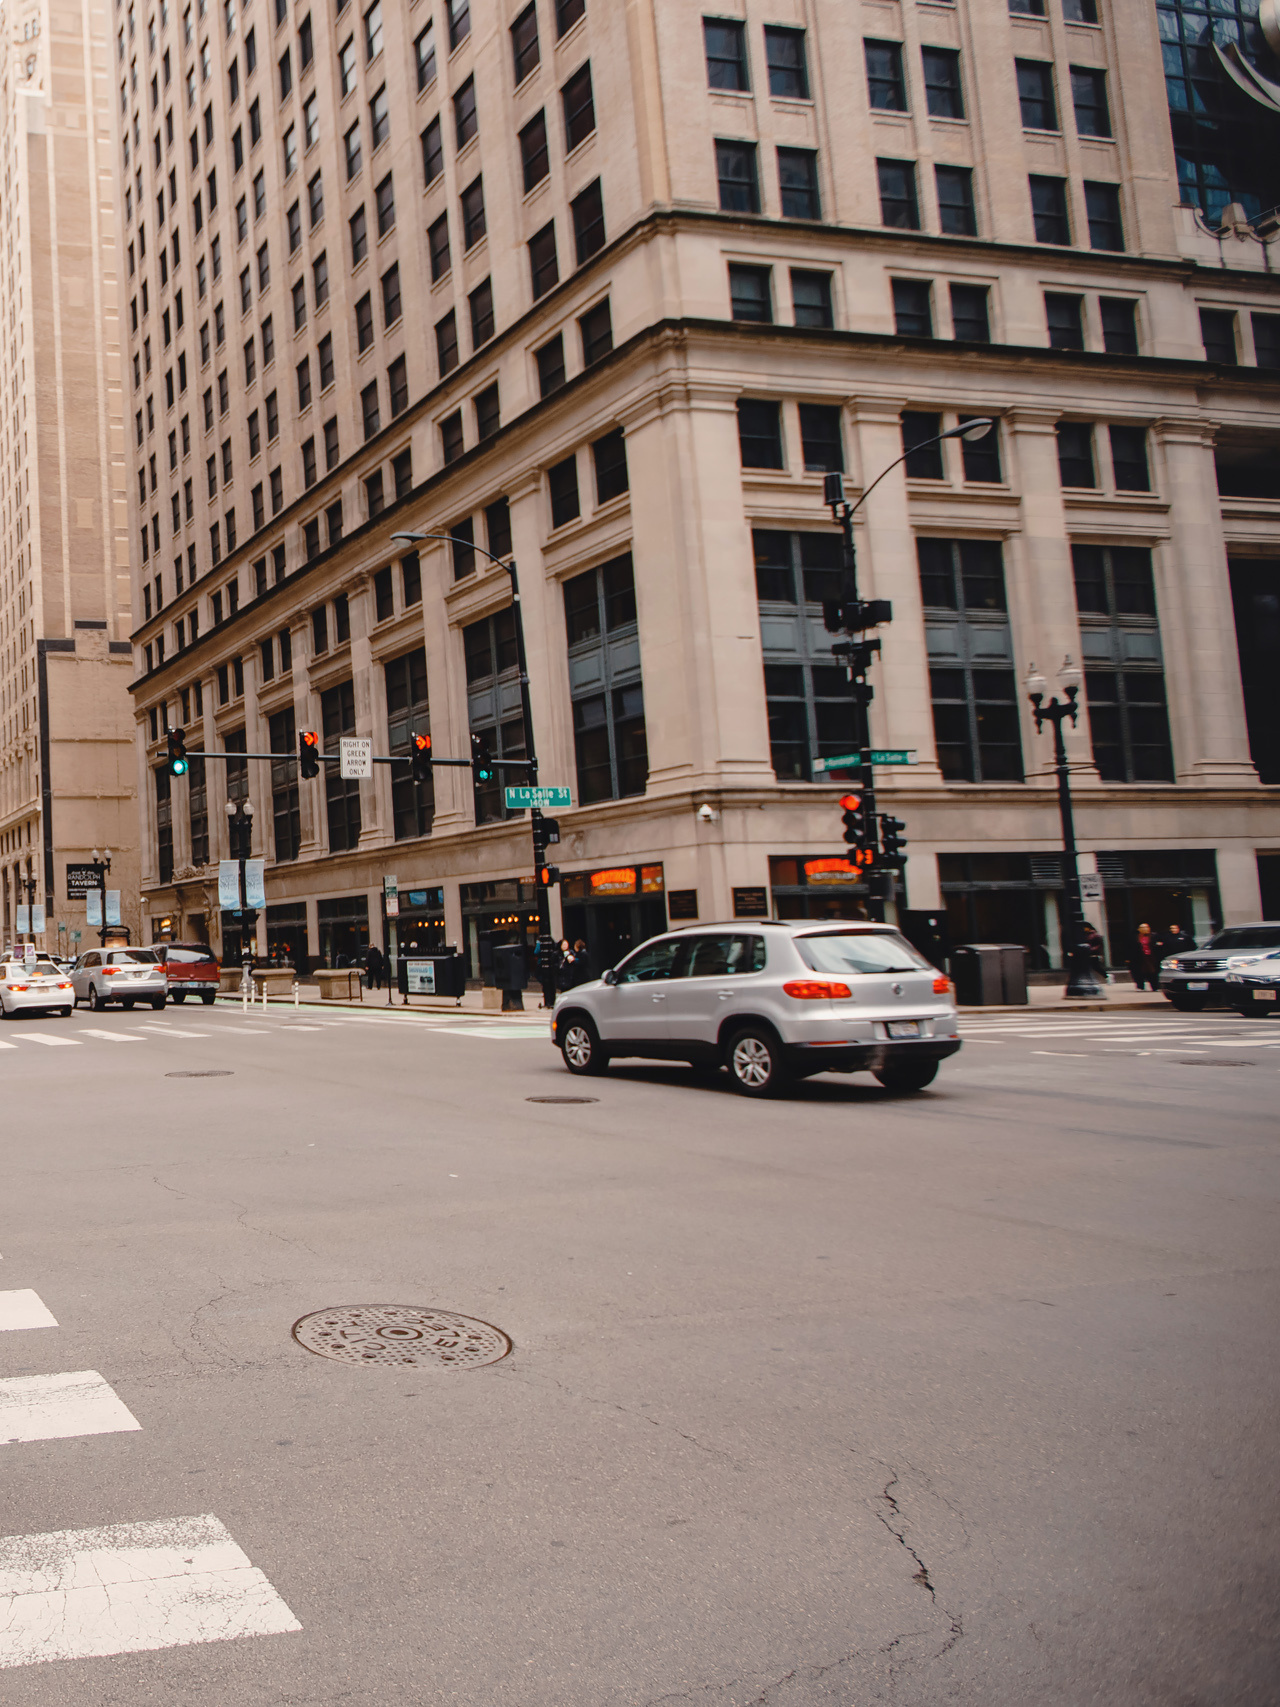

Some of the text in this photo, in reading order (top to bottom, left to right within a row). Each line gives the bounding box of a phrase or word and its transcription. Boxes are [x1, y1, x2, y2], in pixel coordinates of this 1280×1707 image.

[509, 787, 568, 799] N La Salle St
